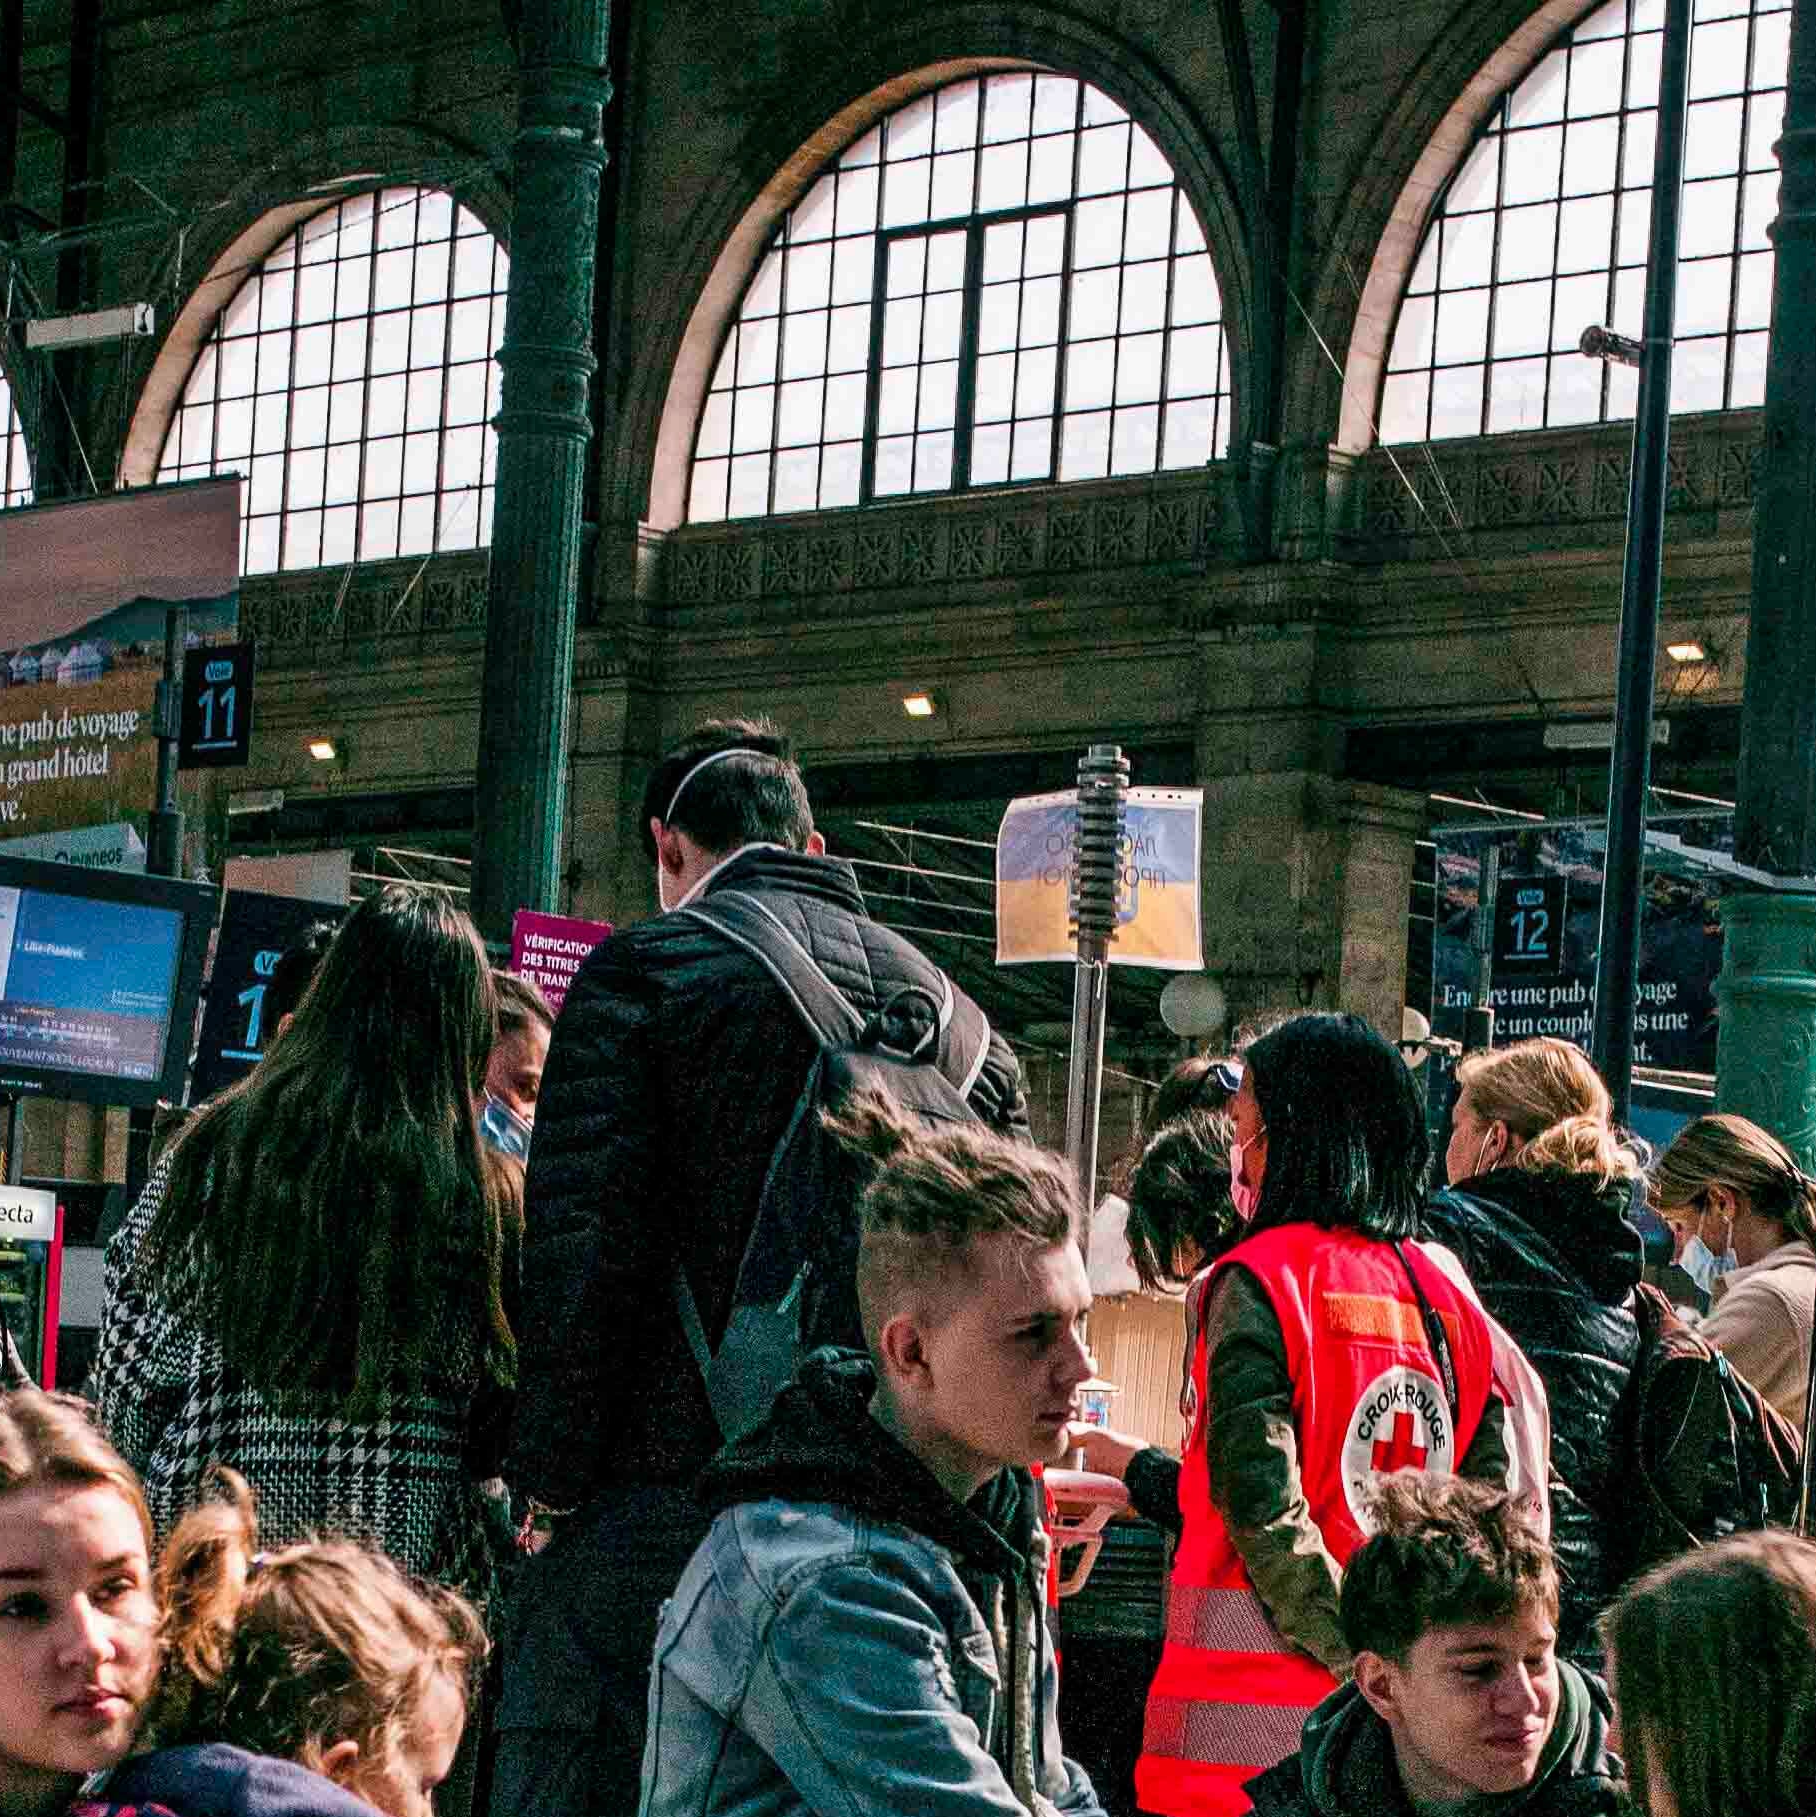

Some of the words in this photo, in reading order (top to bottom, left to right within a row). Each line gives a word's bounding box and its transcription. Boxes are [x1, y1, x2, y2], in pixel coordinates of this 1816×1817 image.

[20, 709, 54, 751] pub
[56, 707, 81, 742] de
[82, 709, 140, 745] voyage
[198, 685, 235, 738] 11
[7, 750, 59, 789] grand
[61, 744, 110, 778] hôtel
[1511, 909, 1549, 952] 12
[520, 969, 536, 984] DE
[522, 952, 543, 967] DES
[545, 955, 580, 973] TITRES
[1511, 986, 1546, 1006] une
[1549, 979, 1585, 1010] pub
[1509, 1016, 1533, 1035] un
[1652, 1011, 1689, 1031] une
[1356, 1383, 1445, 1451] CROIX-ROUGE
